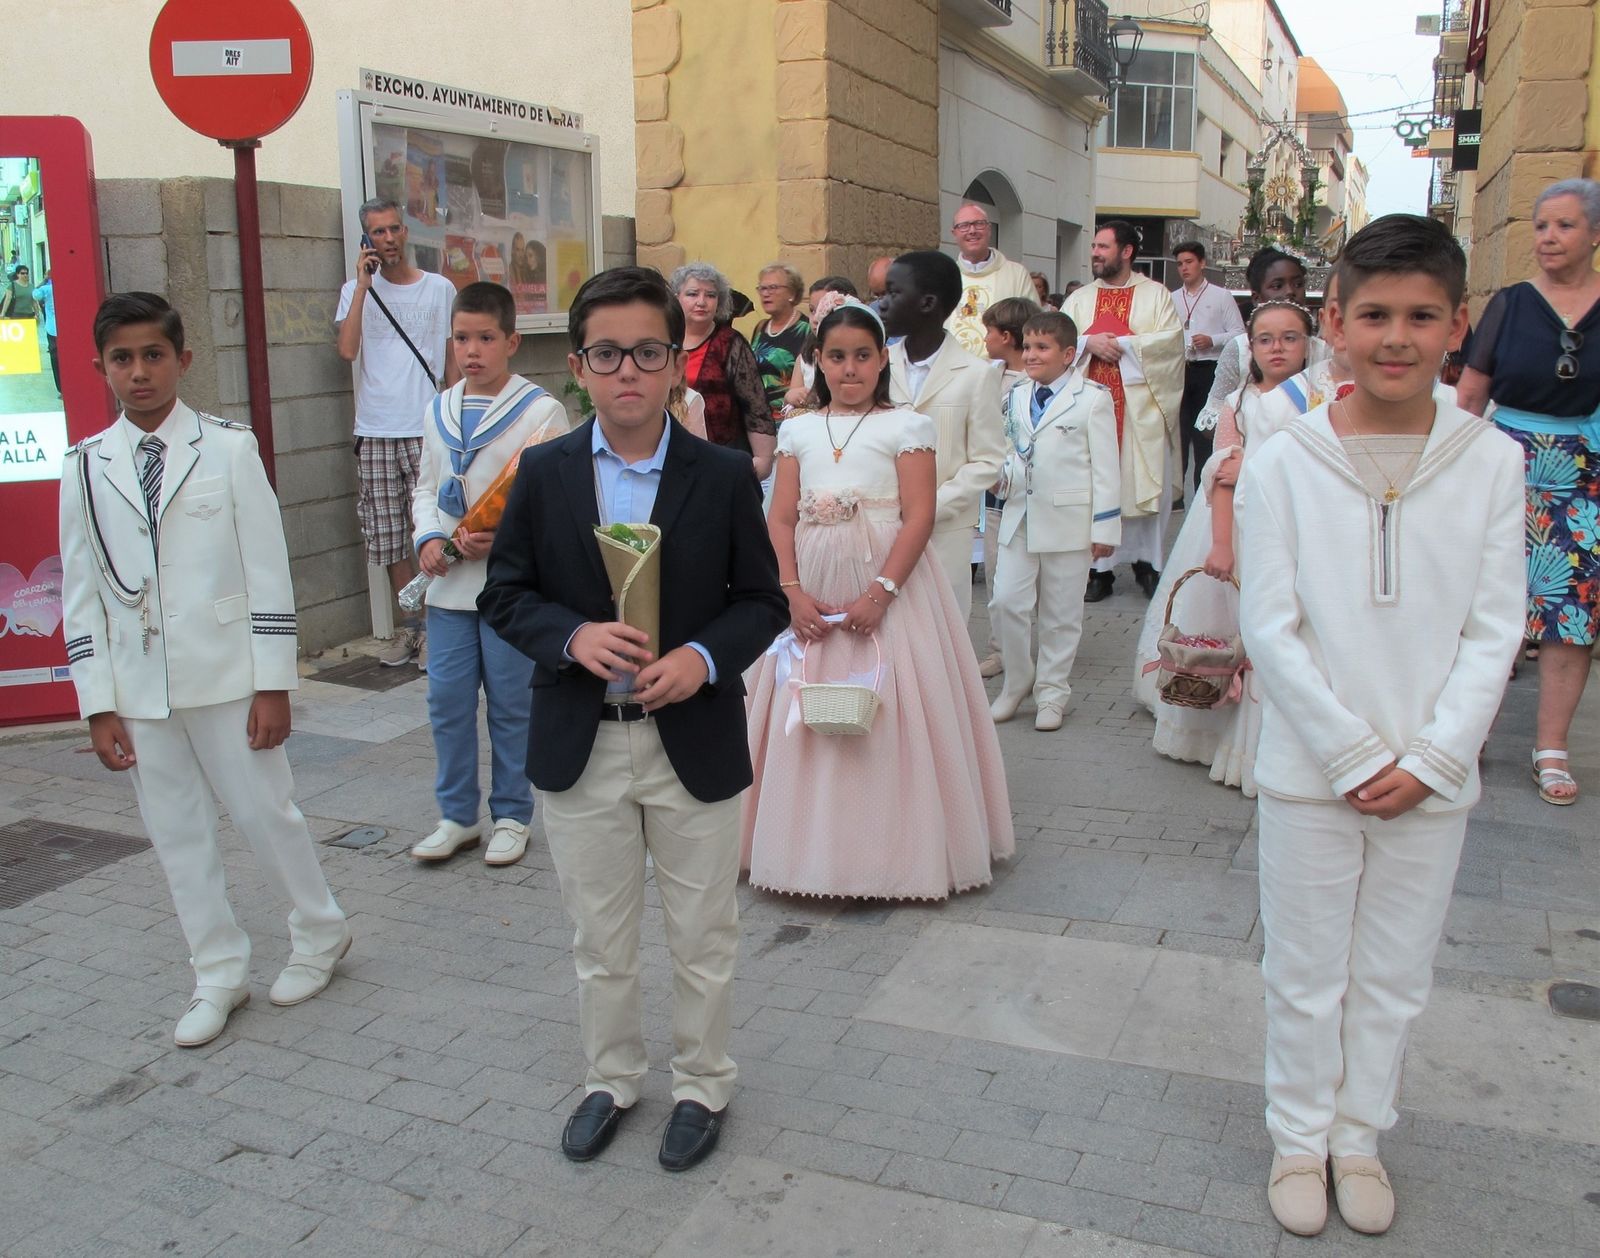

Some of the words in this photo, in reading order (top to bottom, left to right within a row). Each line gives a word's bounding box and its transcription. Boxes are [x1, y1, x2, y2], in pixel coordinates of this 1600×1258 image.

[375, 75, 428, 100] EXCMO.
[432, 87, 527, 119] AYUNTAMIENTO
[530, 106, 543, 122] DE
[1458, 135, 1481, 144] SMAR
[0, 322, 24, 342] IO
[15, 430, 37, 444] LA
[0, 448, 47, 464] ALLA
